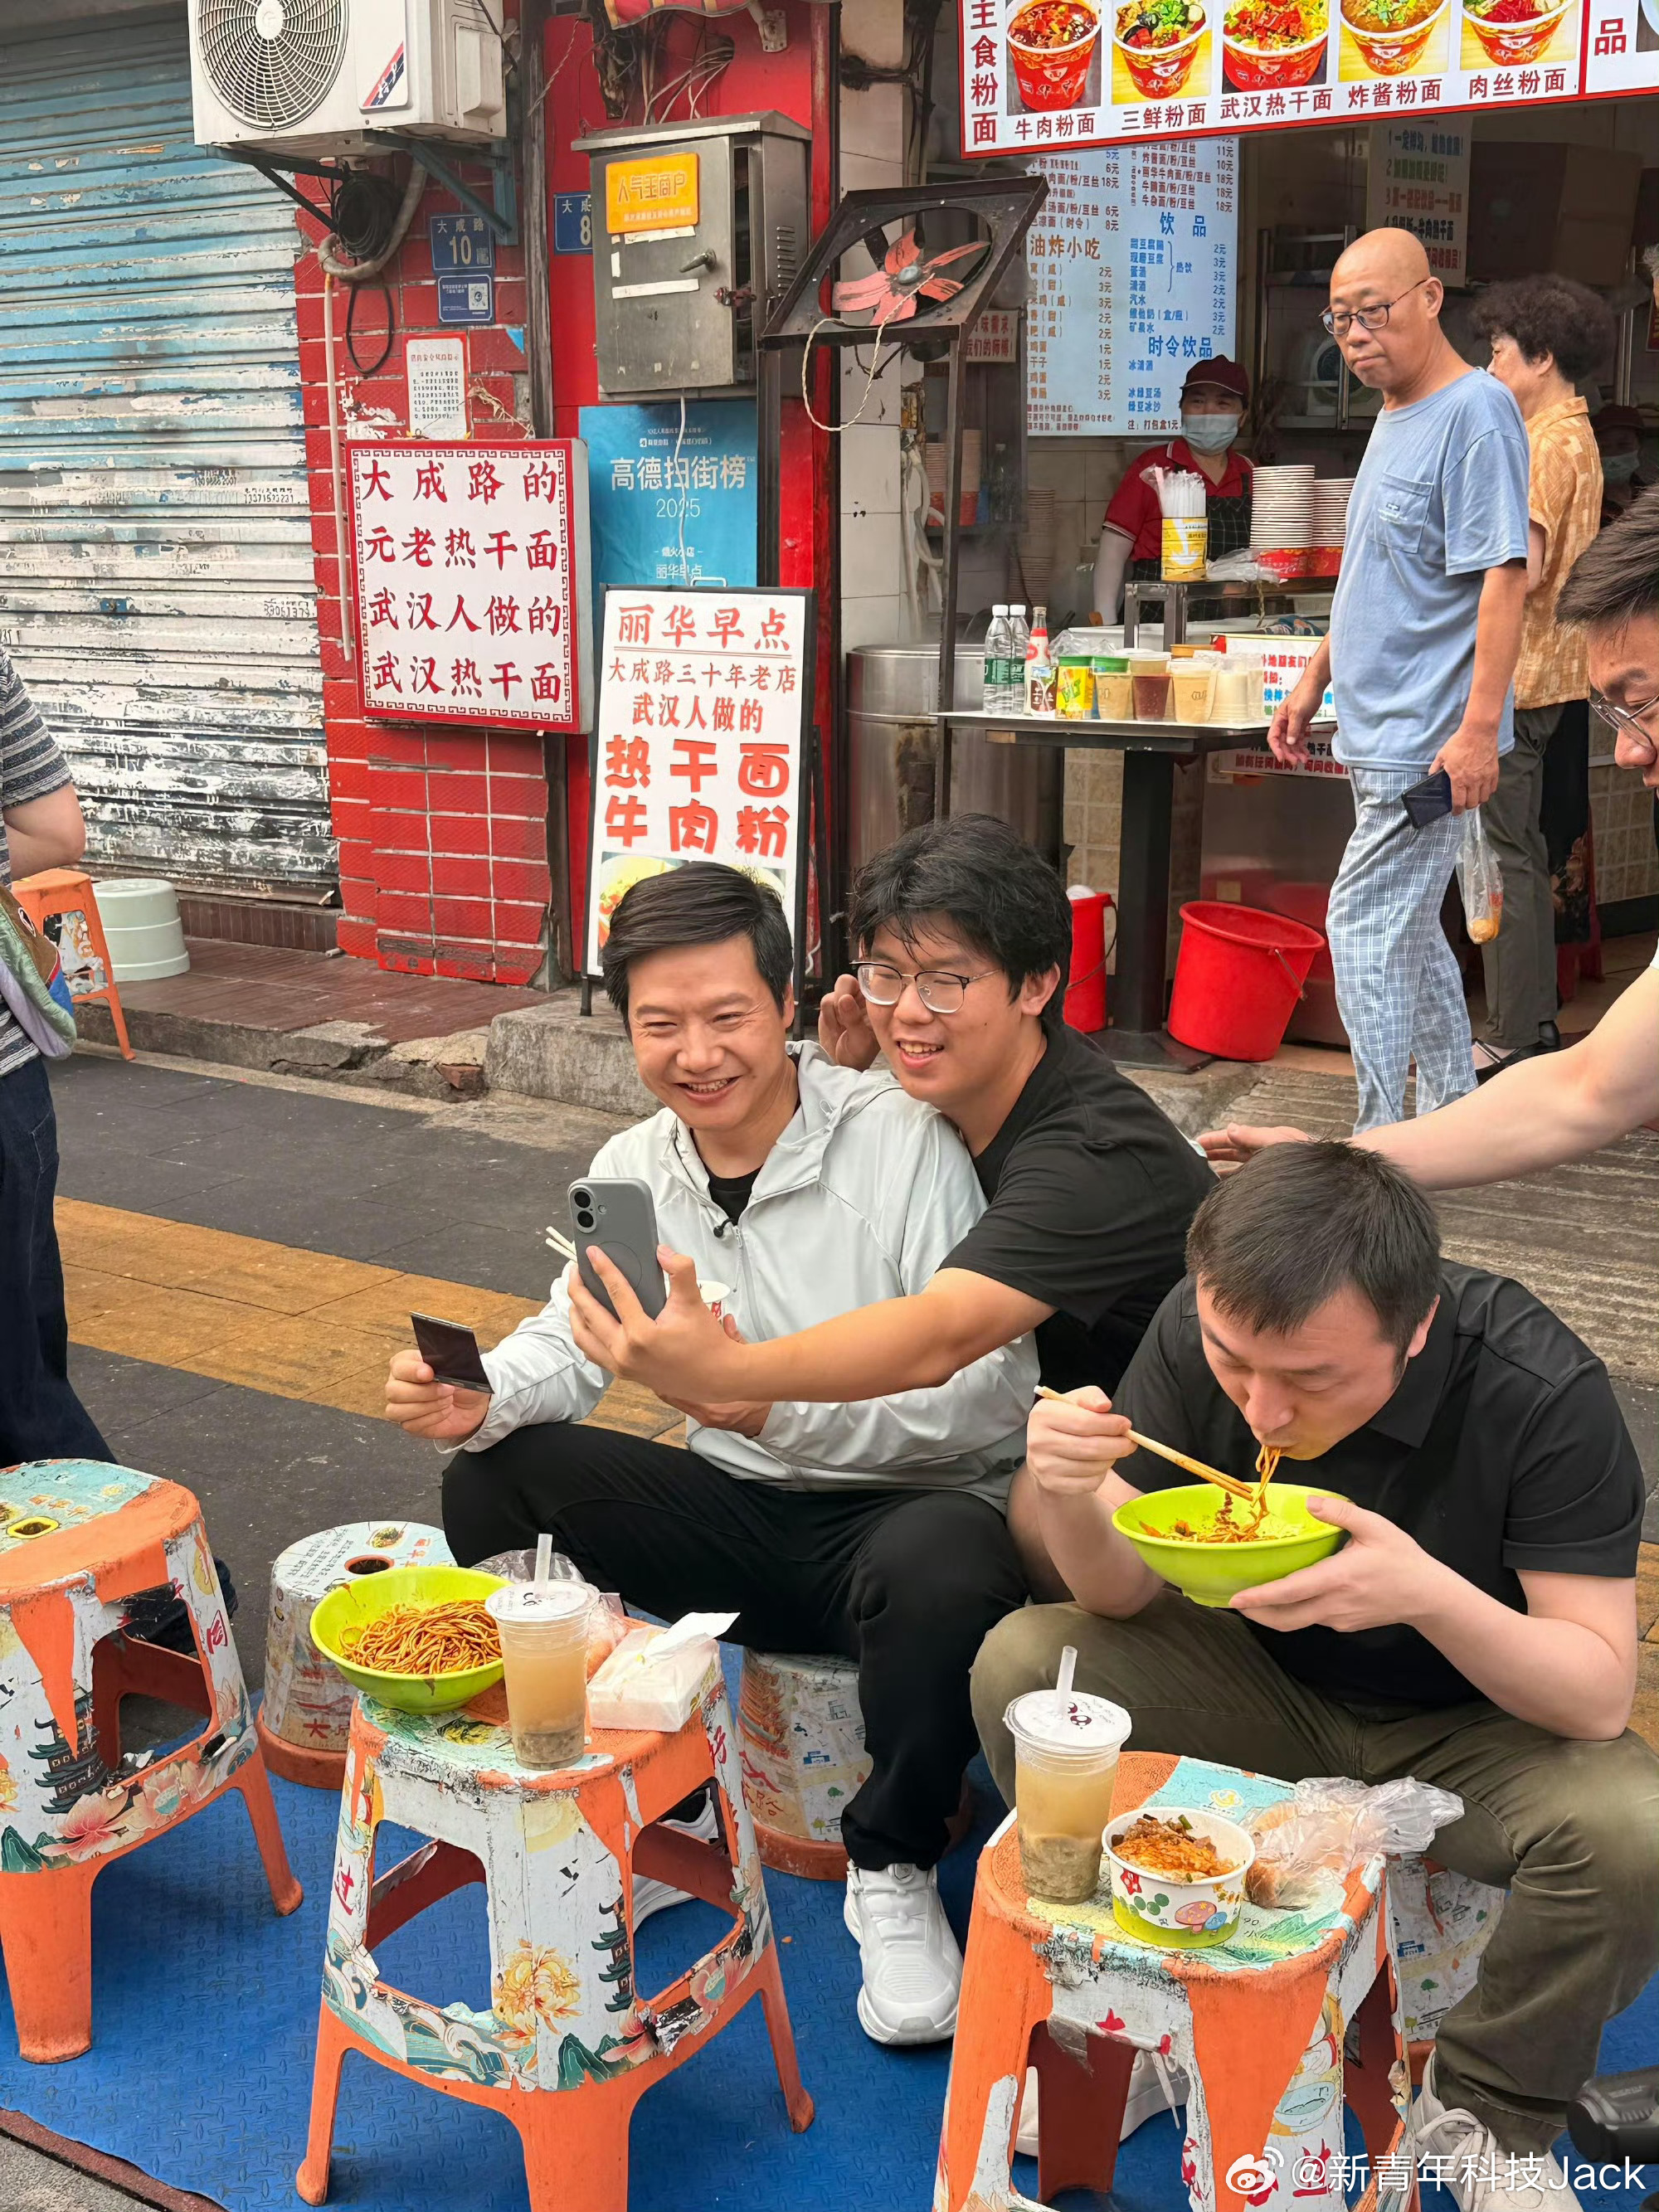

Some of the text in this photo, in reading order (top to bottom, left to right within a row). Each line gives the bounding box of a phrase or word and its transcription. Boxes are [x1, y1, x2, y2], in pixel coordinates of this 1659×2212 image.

[1594, 17, 1627, 56] 品
[970, 0, 999, 145] 主食粉面
[1469, 68, 1567, 100] 肉丝粉面
[1220, 88, 1333, 120] 武汉热干面
[1349, 78, 1443, 109] 炸酱粉面
[1014, 113, 1096, 141] 牛肉粉面
[1121, 103, 1207, 131] 三鲜粉面
[617, 172, 686, 203] 人气王商户
[436, 218, 484, 236] 大成路
[1160, 211, 1207, 238] 饮品
[449, 235, 473, 265] 10
[1030, 234, 1101, 260] 油炸小吃
[1099, 266, 1112, 279] 2元
[1098, 281, 1112, 294] 3元
[1129, 294, 1146, 306] 汽水
[1098, 297, 1112, 309] 3元
[1098, 312, 1112, 324] 2元
[1129, 322, 1155, 333] 矿泉水
[1098, 328, 1112, 340] 2元
[1148, 336, 1213, 358] 时令饮品
[1099, 343, 1112, 355] 1元
[1099, 358, 1112, 370] 1元
[1098, 374, 1112, 386] 2元
[1097, 389, 1112, 401] 3元
[362, 459, 558, 505] 大成路的
[610, 454, 747, 492] 高德扫街榜
[655, 498, 701, 518] 2025
[364, 526, 558, 571] 元老热干面
[368, 586, 562, 637] 武汉人做的
[619, 604, 790, 651] 丽华早点
[372, 650, 562, 703] 武汉热干面
[608, 657, 797, 694] 大成路三十年老店
[632, 692, 763, 734] 武汉人做的
[604, 734, 790, 798] 热干面
[604, 795, 791, 858] 牛肉粉
